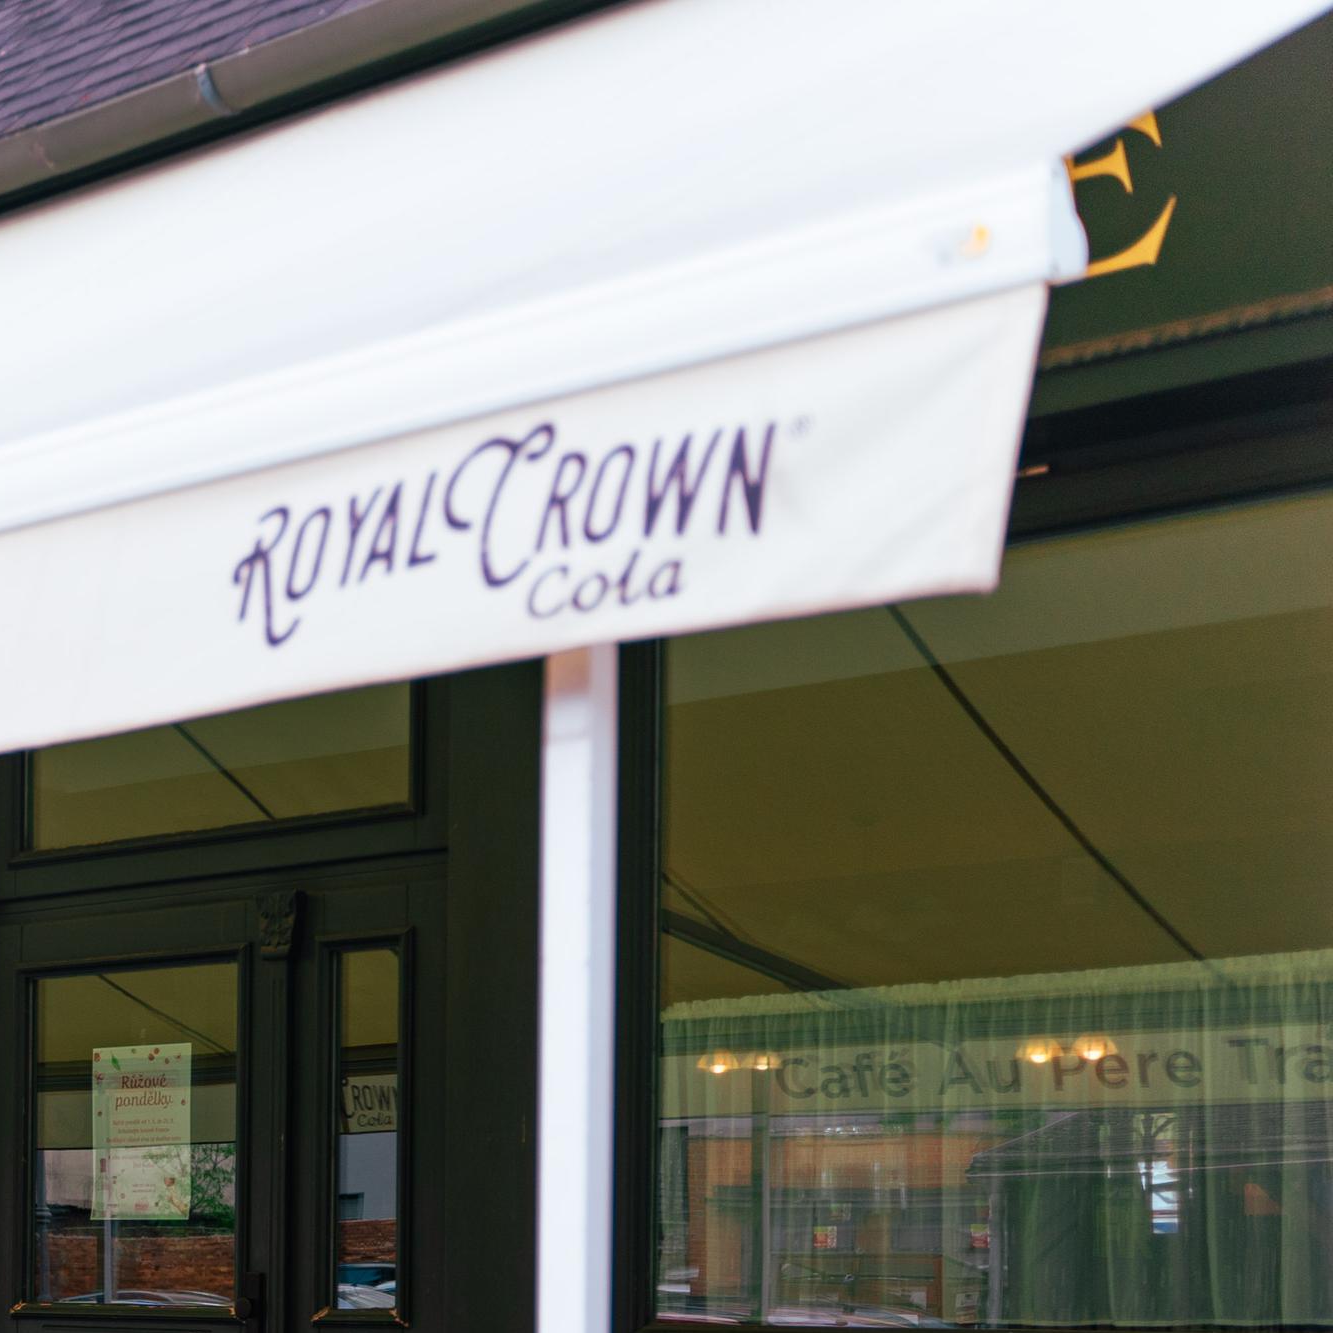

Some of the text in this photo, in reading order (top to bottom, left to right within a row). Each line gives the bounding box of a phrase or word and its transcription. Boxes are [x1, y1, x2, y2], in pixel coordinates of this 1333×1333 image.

[233, 421, 777, 648] ROYAL CROWN
[525, 549, 684, 620] Cola
